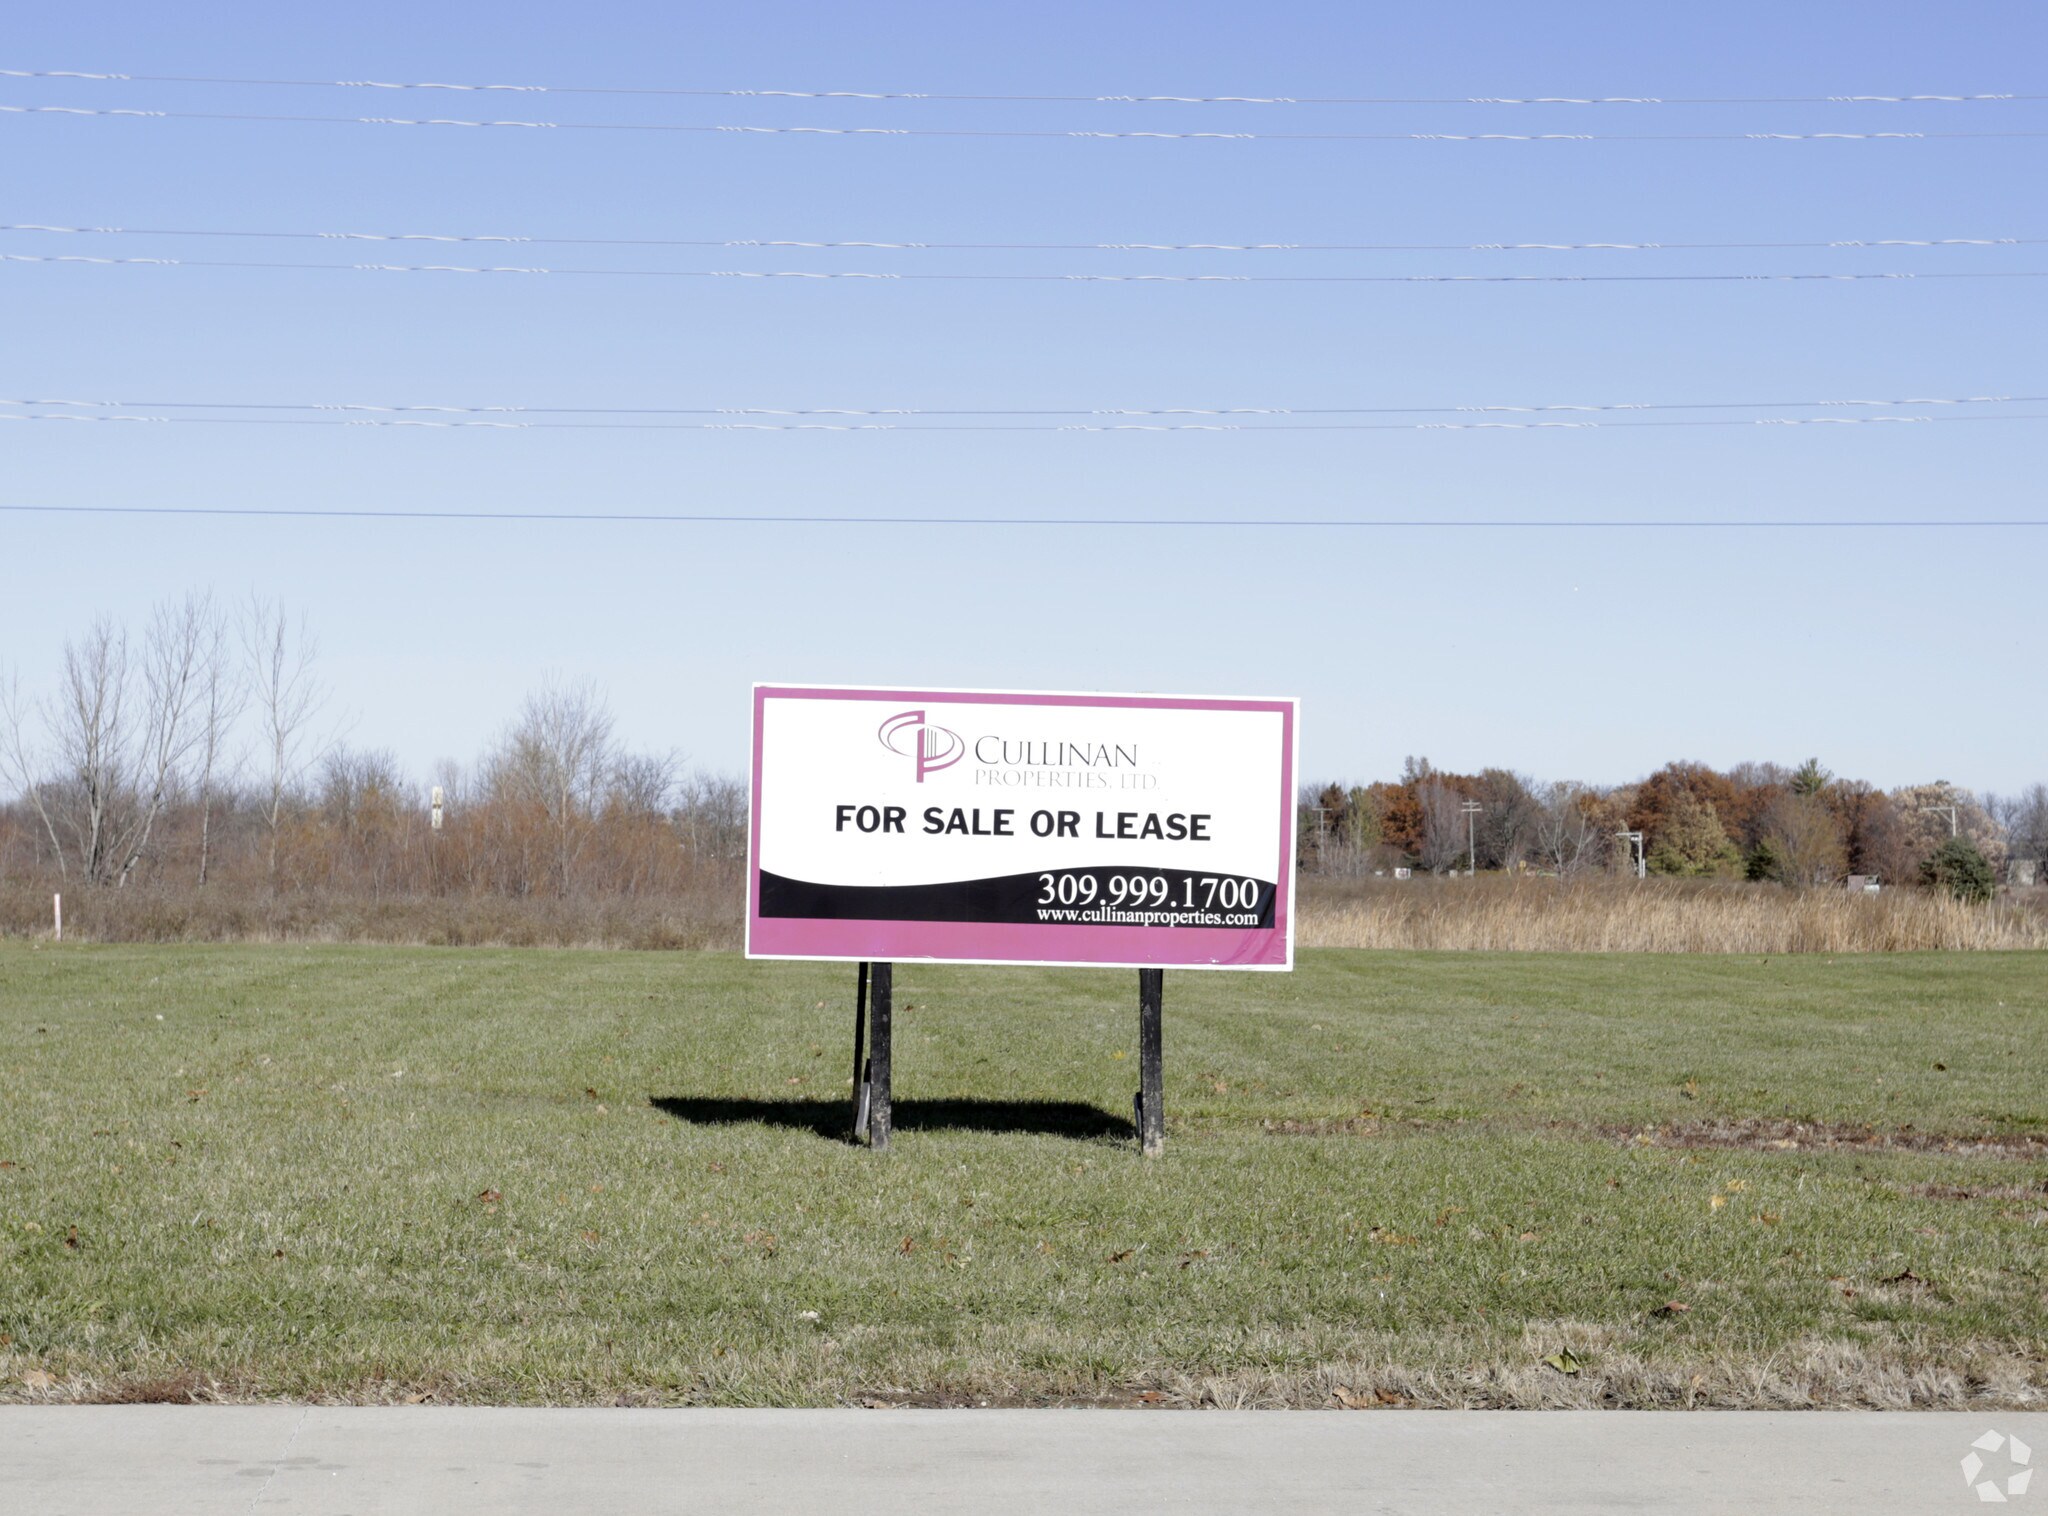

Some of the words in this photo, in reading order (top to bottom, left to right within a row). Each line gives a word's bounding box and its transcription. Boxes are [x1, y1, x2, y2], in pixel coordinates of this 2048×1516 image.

[974, 735, 1138, 767] CULLINAN
[835, 804, 907, 834] FOR
[922, 806, 1015, 836] SALE
[1030, 809, 1081, 838] OR
[1095, 811, 1212, 841] LEASE
[1037, 873, 1259, 909] 309.999.1700
[1037, 907, 1258, 927] www.cullinanproperties.com
